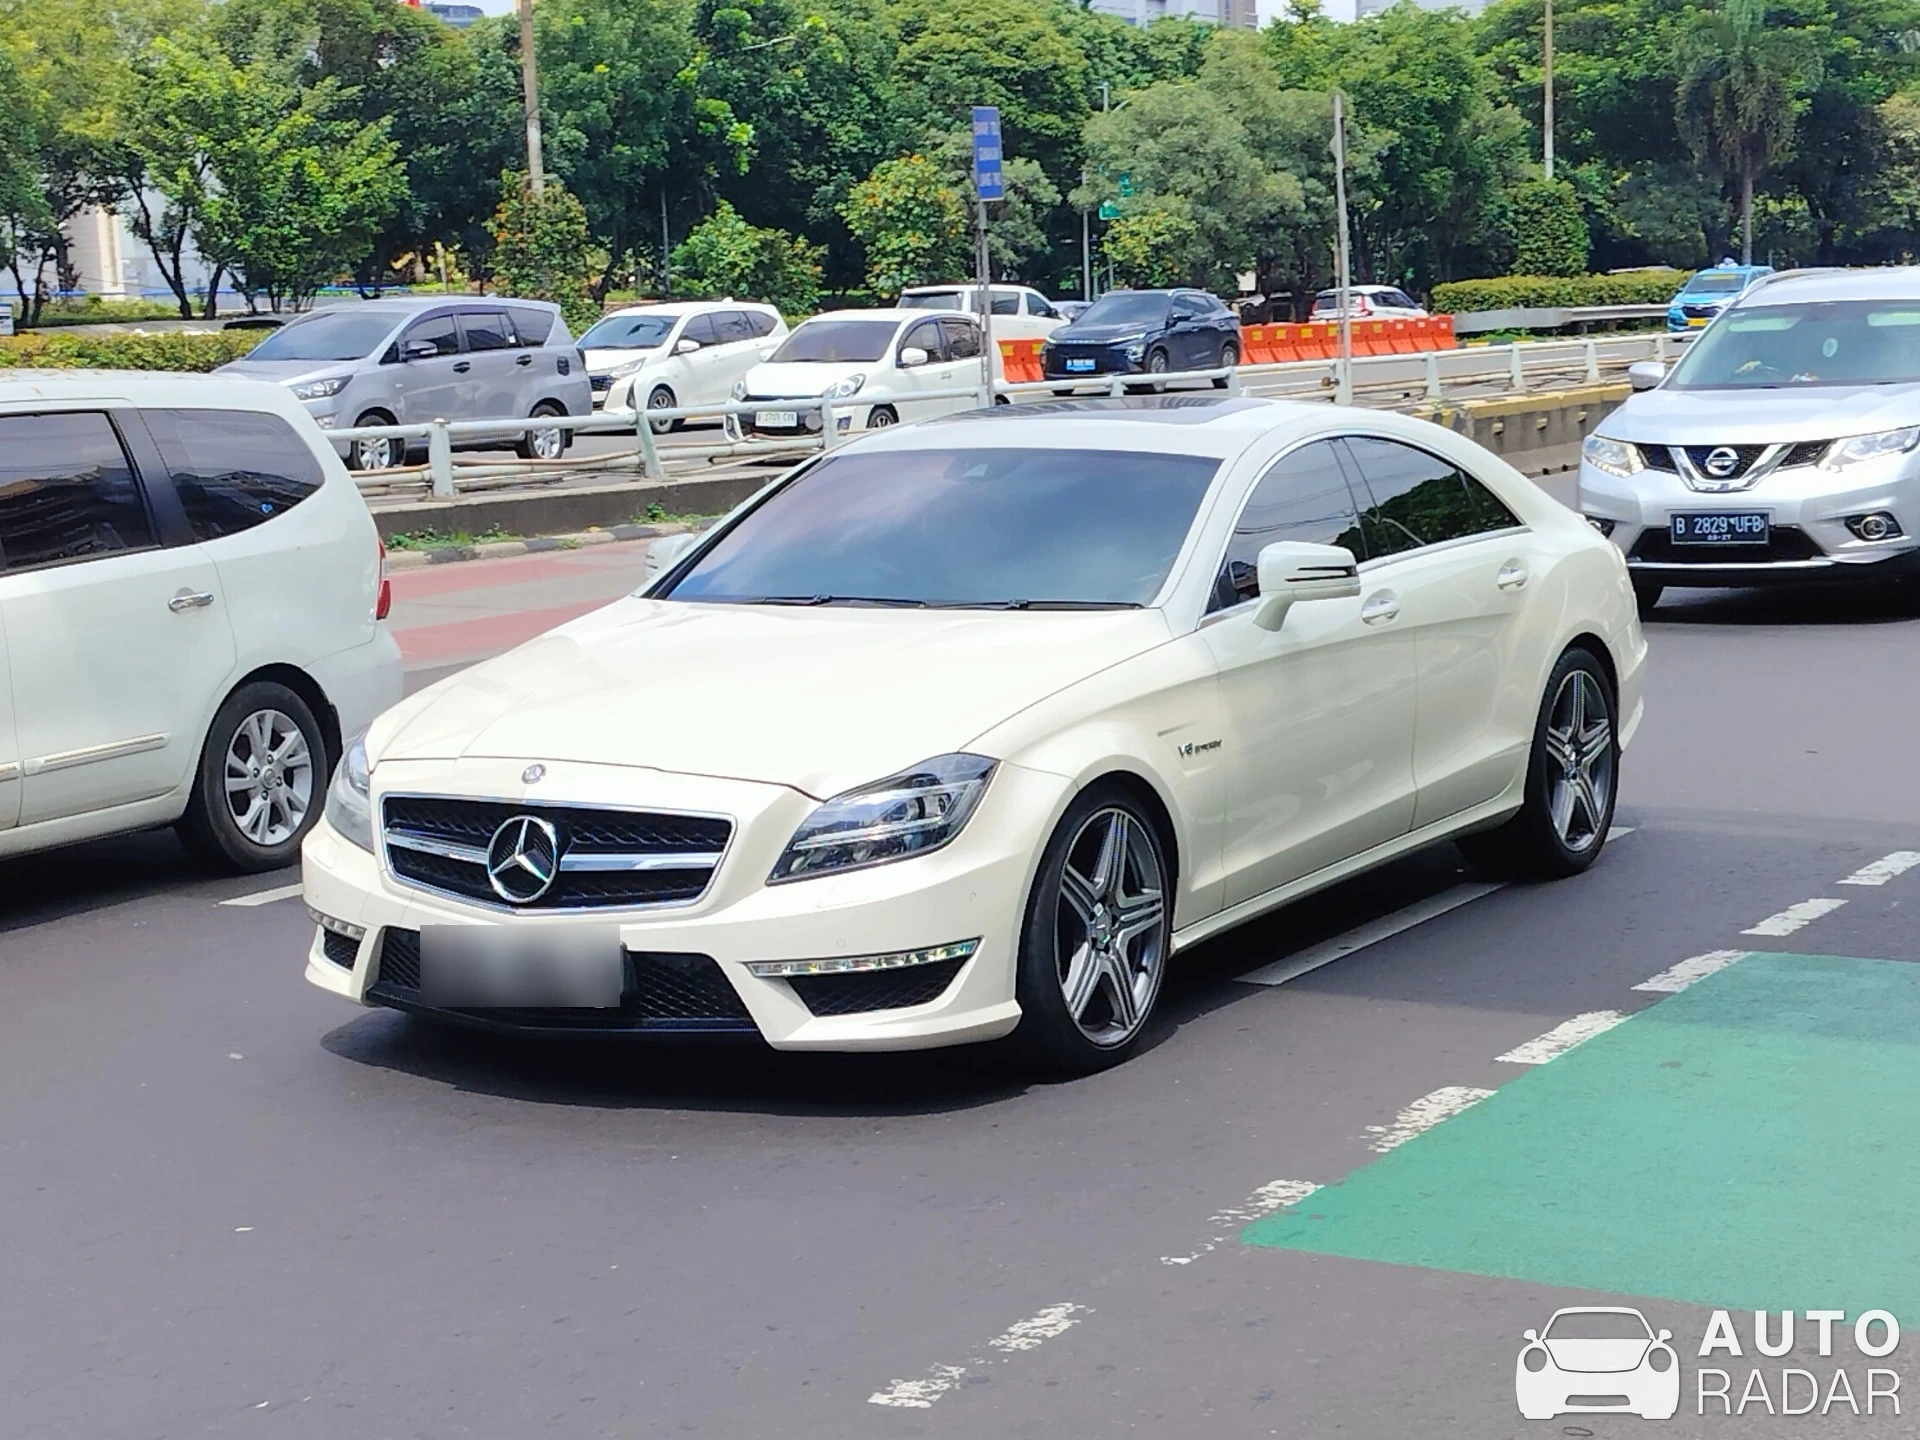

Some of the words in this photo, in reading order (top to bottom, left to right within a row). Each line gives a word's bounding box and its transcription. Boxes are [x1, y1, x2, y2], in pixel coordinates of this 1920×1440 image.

[1676, 517, 1686, 534] B
[1693, 516, 1728, 534] 2829
[1735, 515, 1761, 533] UFB
[1178, 742, 1193, 759] V8
